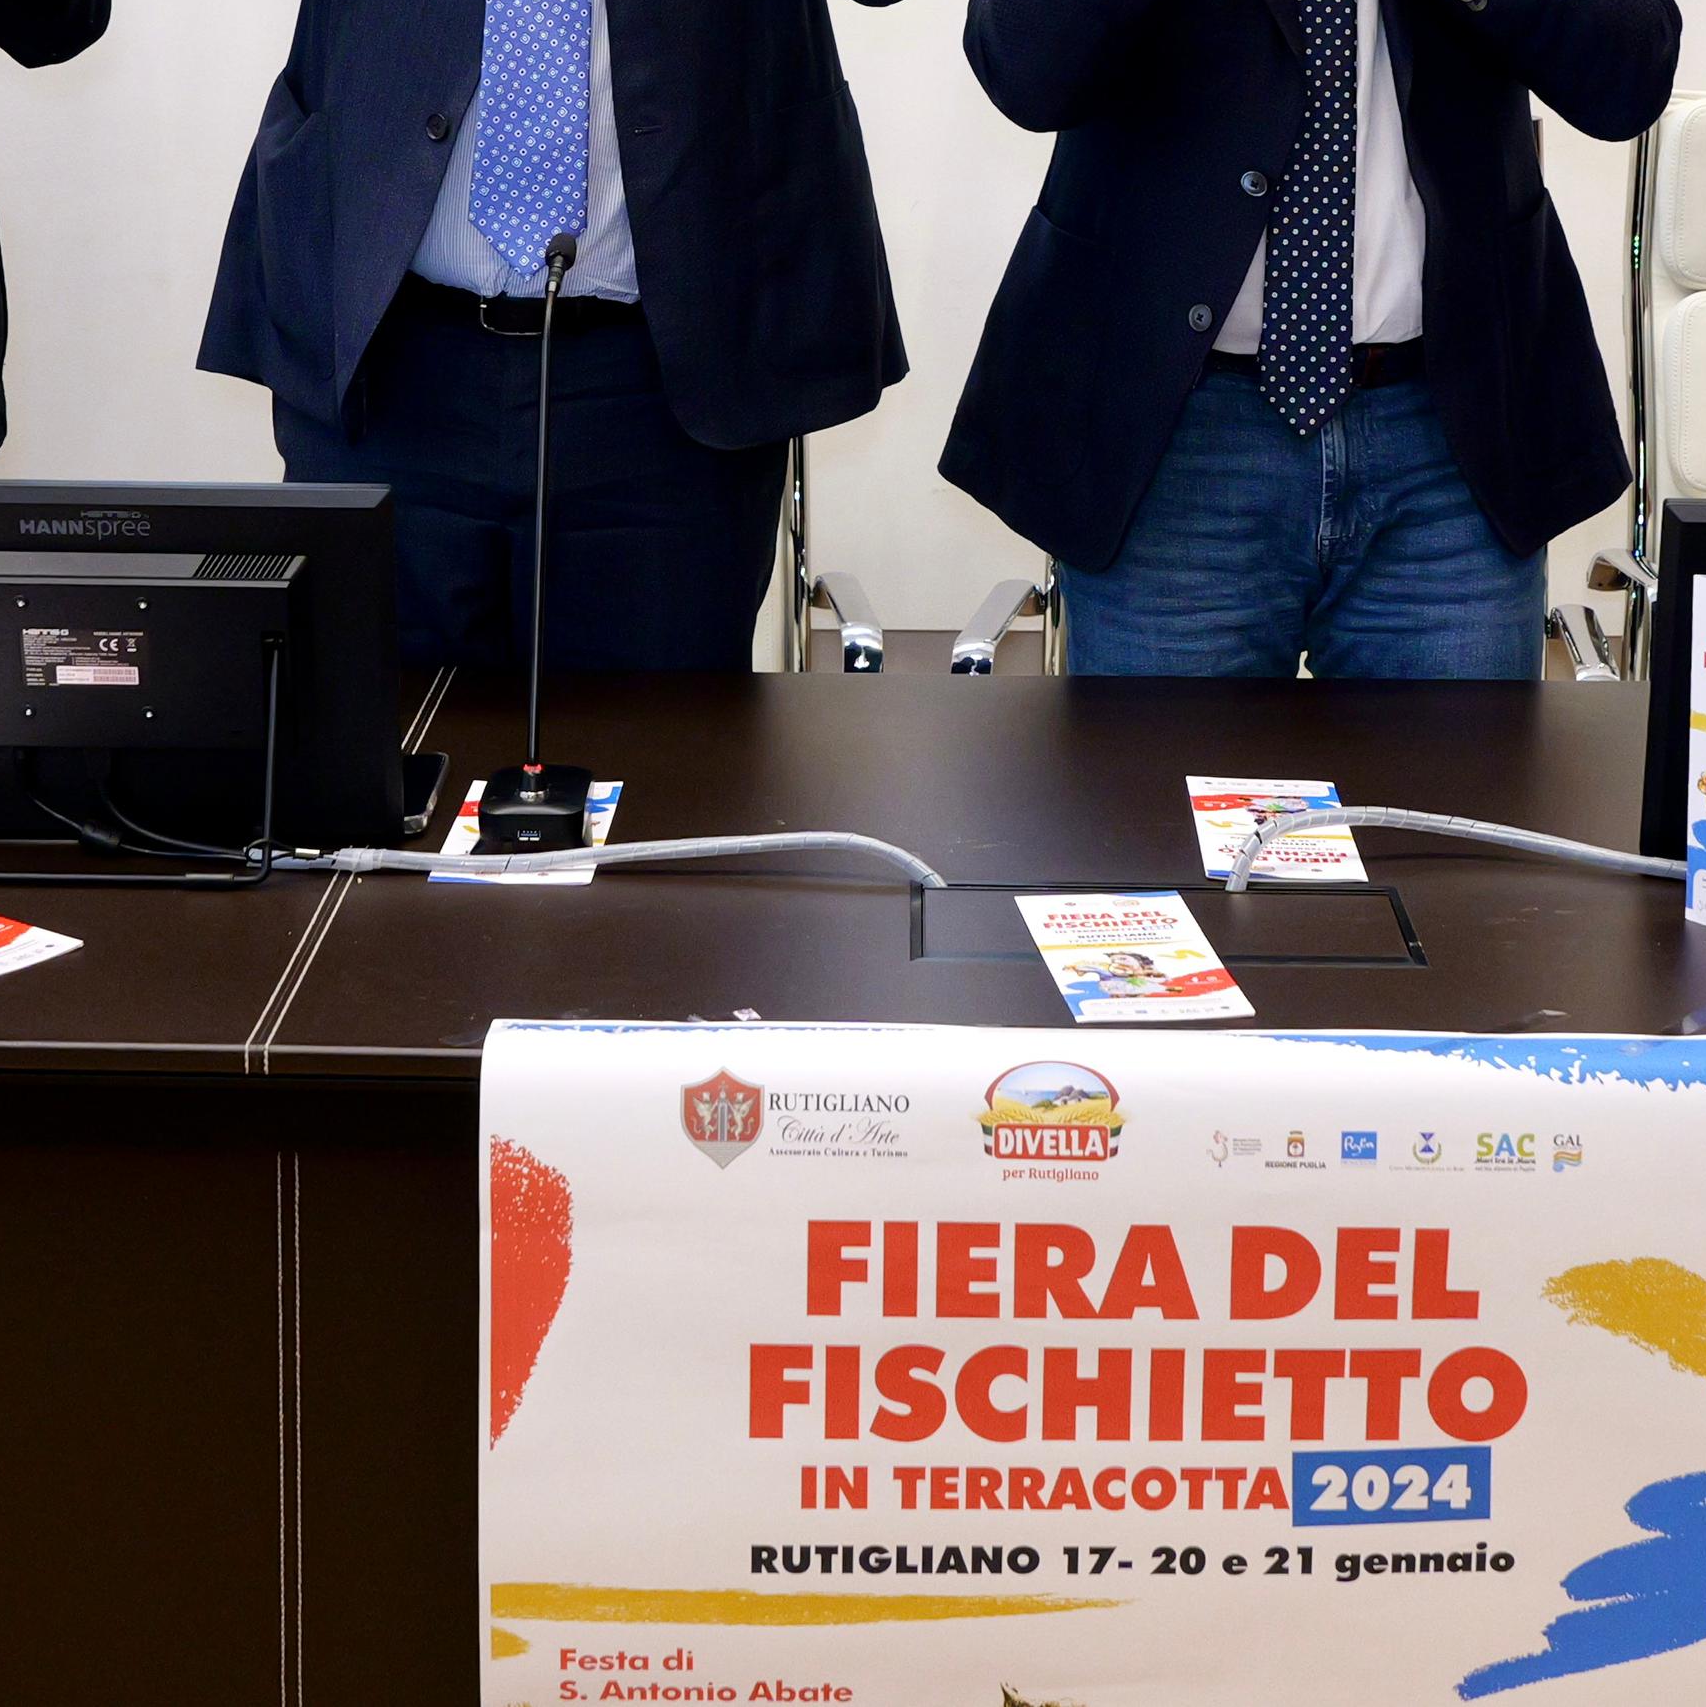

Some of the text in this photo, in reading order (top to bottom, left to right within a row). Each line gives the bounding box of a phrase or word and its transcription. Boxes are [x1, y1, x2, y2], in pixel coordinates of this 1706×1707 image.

[1043, 917, 1179, 929] FISCHIETTO
[1047, 910, 1168, 921] FIERA DEL
[768, 1092, 910, 1113] RUTIGLIANO
[777, 1115, 825, 1144] Città
[1553, 1134, 1583, 1147] GAL
[824, 1147, 860, 1157] Cultura
[871, 1148, 909, 1158] Turismo
[997, 1127, 1105, 1158] DIVELLA
[1476, 1132, 1536, 1157] SAC
[1002, 1167, 1100, 1183] per Rutigliano
[1264, 1161, 1327, 1170] REGIONE PUGLIA
[807, 1219, 1481, 1321] FIERA DEL
[748, 1343, 1529, 1442] FISCHIETTO
[799, 1463, 1473, 1512] IN TERRACOTTA 2024
[749, 1544, 1041, 1575] RUTIGLIANO
[1151, 1545, 1208, 1576] 20
[1221, 1552, 1249, 1577] e
[1263, 1544, 1314, 1576] 21
[1334, 1541, 1517, 1583] gennaio
[558, 1647, 694, 1672] Festa di
[558, 1679, 854, 1703] S. Antonio Abate
